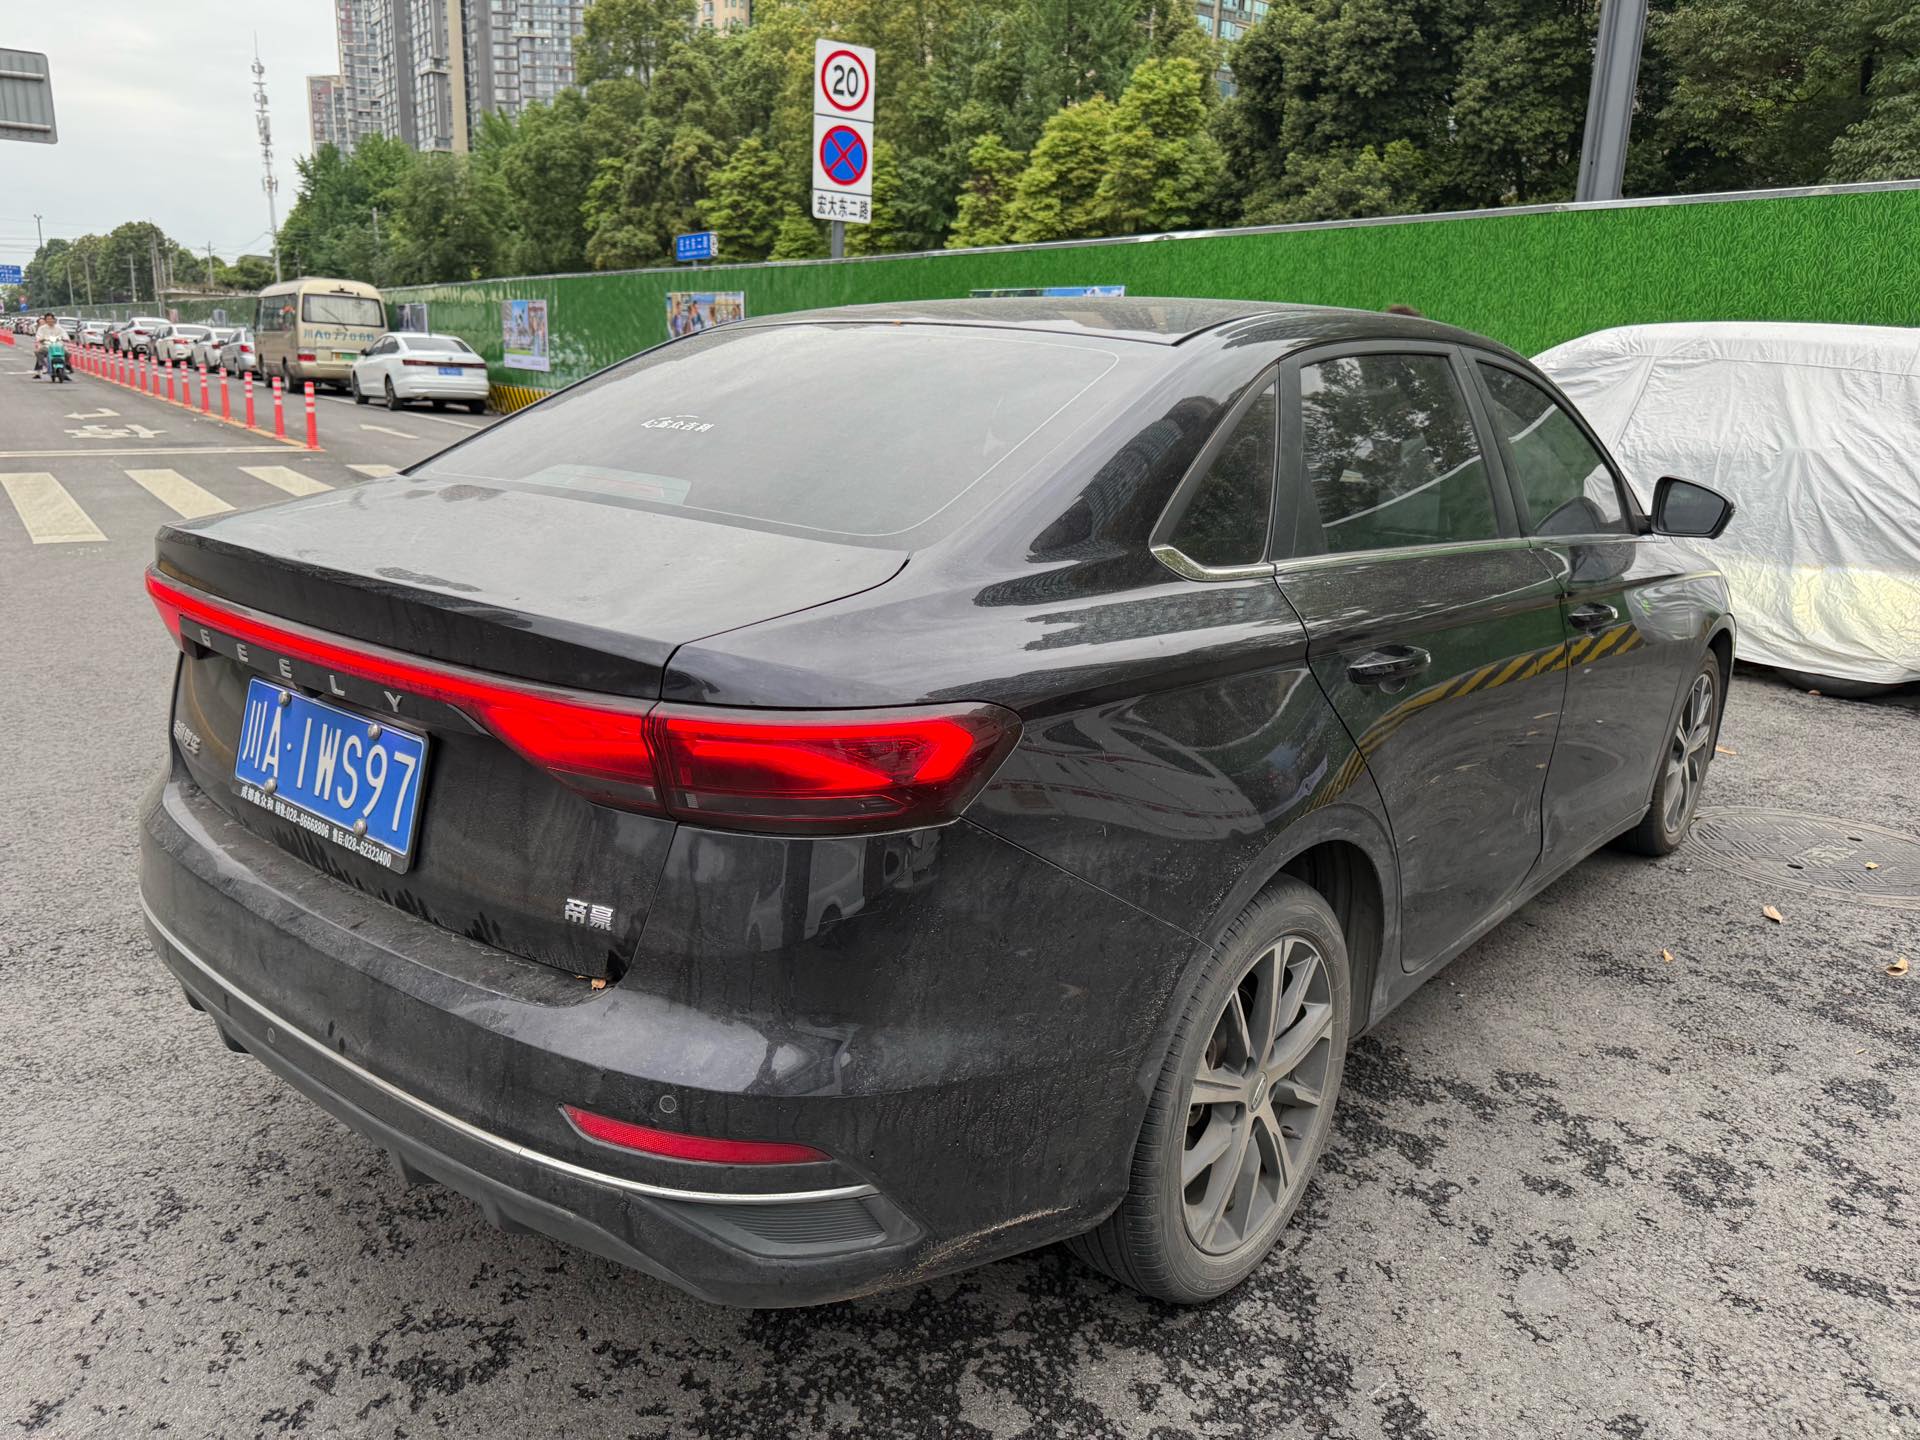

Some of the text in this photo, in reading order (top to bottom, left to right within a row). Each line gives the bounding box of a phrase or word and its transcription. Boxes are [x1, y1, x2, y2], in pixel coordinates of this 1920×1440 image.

[832, 64, 858, 97] 20
[816, 194, 868, 220] 宏大东二路
[200, 628, 402, 713] GEELY
[565, 898, 613, 931] 帝豪
